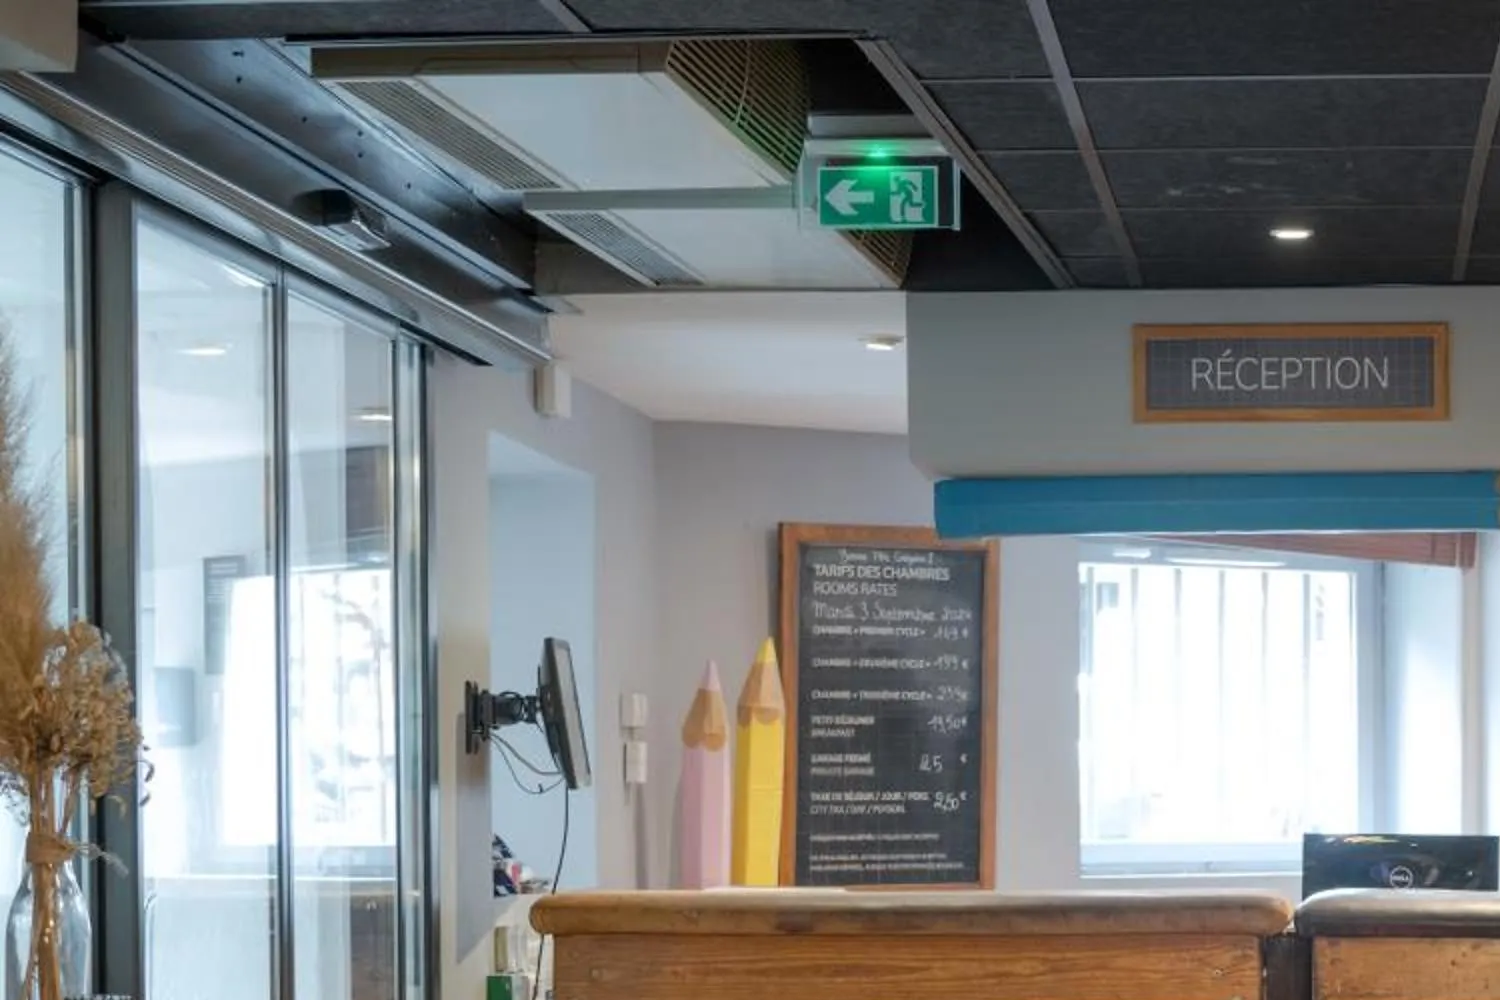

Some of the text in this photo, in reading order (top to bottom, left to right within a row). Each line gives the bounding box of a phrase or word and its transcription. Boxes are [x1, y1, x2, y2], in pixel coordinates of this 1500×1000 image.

[1191, 349, 1389, 391] RÉCEPTION
[813, 564, 950, 581] TARIFS DES CHAMBRES
[813, 581, 897, 597] ROOMS RATES
